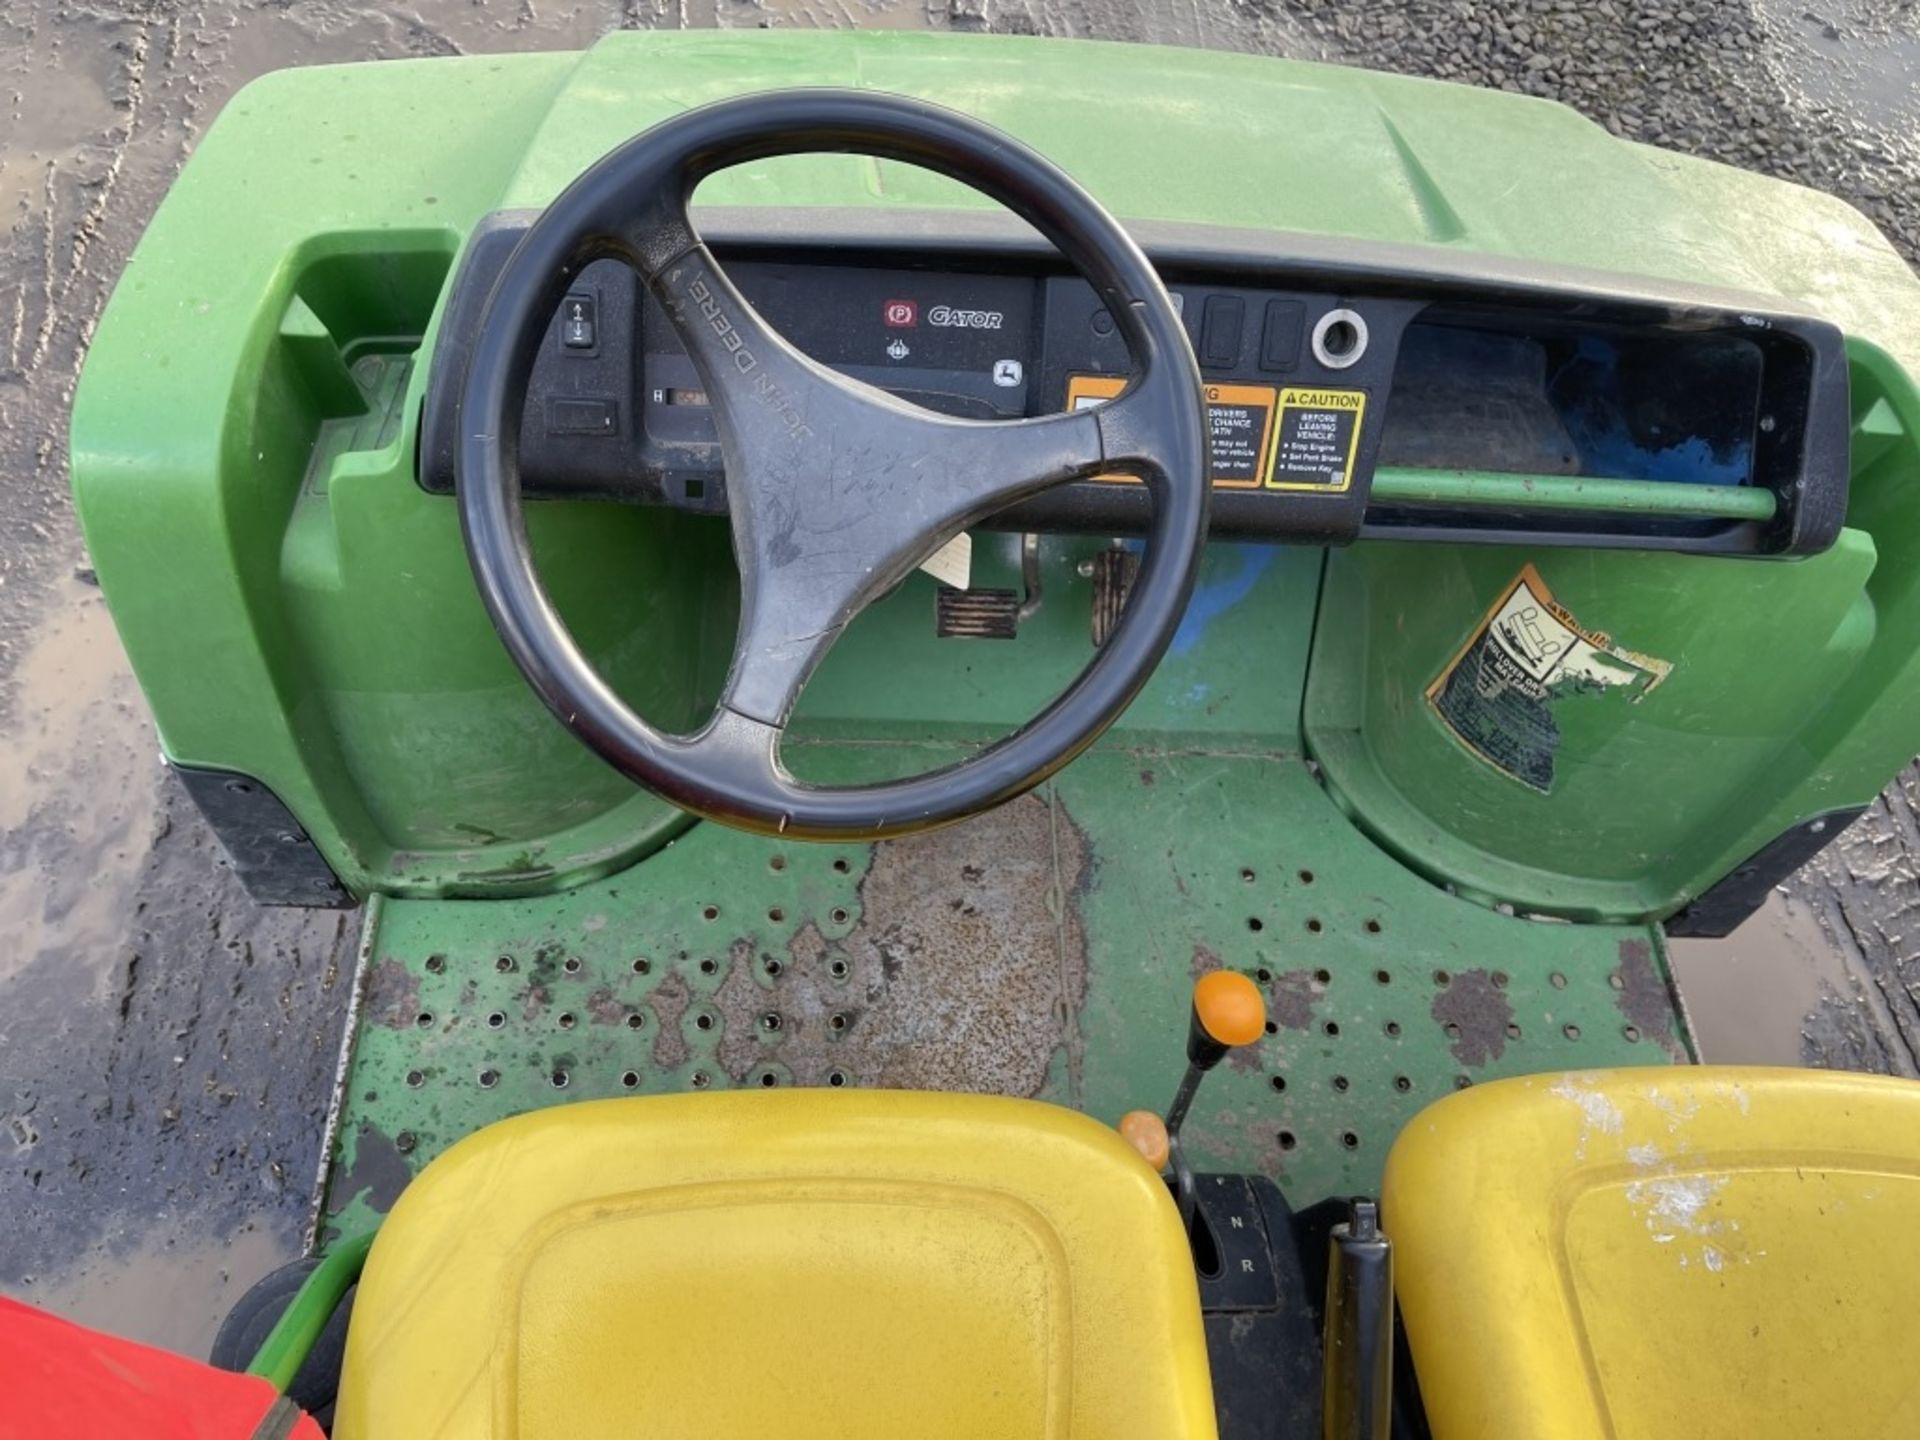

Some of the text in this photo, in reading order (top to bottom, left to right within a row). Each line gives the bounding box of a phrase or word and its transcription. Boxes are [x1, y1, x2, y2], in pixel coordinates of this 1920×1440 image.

[928, 305, 1004, 329] GATOR
[688, 279, 758, 375] DEERE
[753, 373, 814, 439] JOHN
[1299, 392, 1360, 408] CAUTION
[1301, 413, 1337, 422] BEFORE
[1299, 422, 1337, 432] LEAVING
[1291, 442, 1336, 453] Stop Engine
[1289, 452, 1301, 461] Set
[1287, 463, 1334, 473] Remove Key
[1231, 1216, 1244, 1229] N
[1241, 1259, 1255, 1272] R
